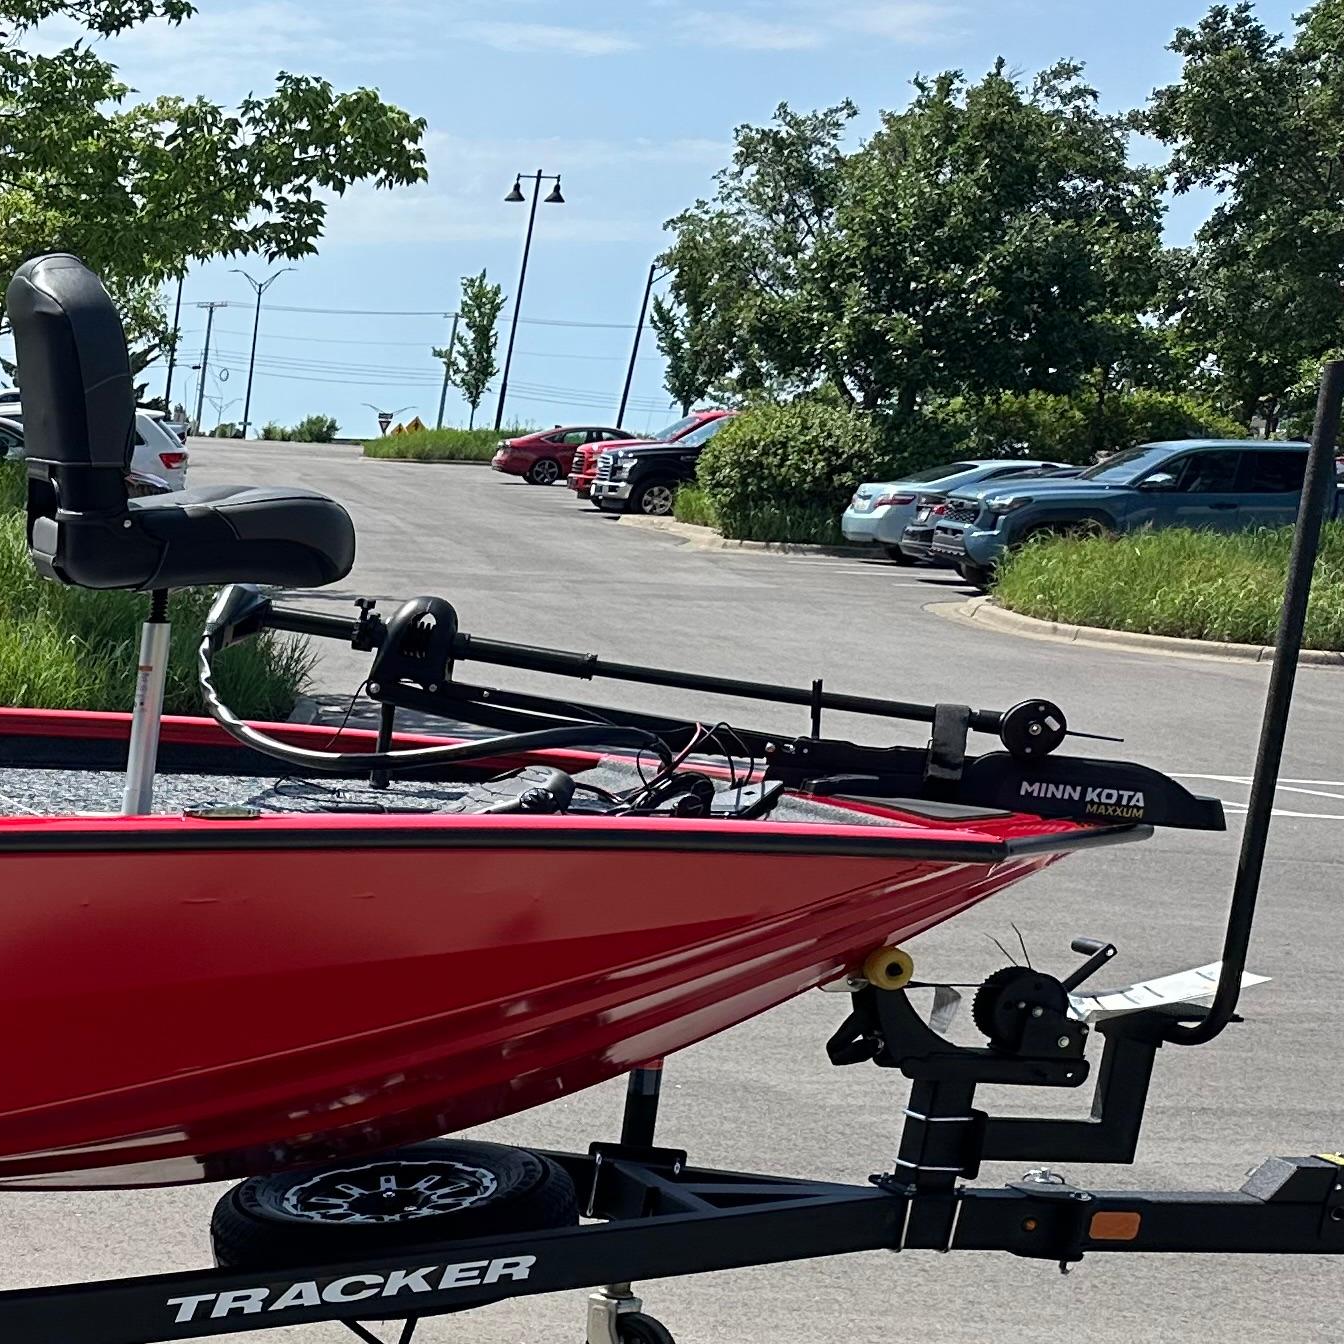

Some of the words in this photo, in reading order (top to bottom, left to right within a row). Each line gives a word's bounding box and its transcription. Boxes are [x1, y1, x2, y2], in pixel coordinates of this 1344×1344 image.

[1020, 781, 1081, 800] MINN
[1085, 787, 1145, 807] KOTA
[1086, 804, 1144, 819] MAXXUM
[167, 1254, 537, 1323] TRACKER
